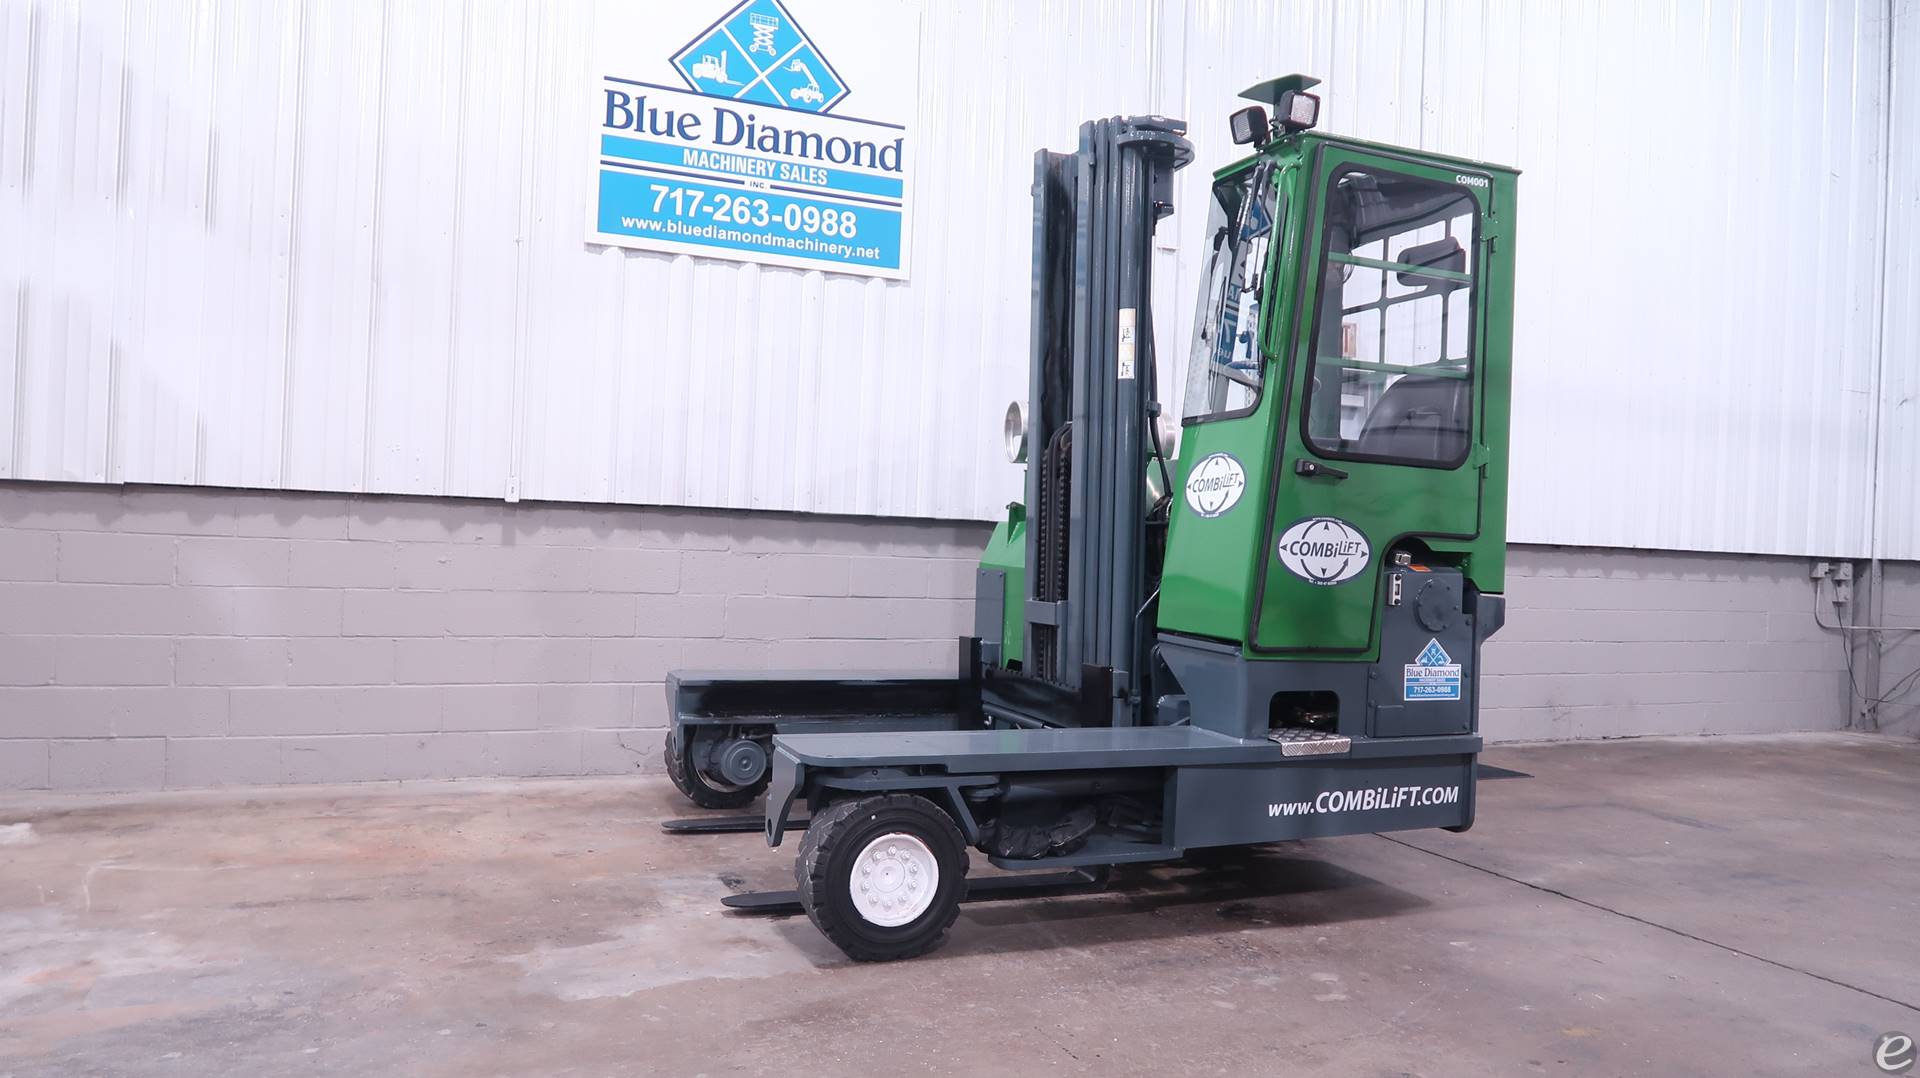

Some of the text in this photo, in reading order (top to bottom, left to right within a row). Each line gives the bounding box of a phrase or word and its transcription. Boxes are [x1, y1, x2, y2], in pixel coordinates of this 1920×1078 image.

[602, 89, 904, 173] Blue Diamond
[683, 149, 828, 185] MACHINERY SALES
[749, 180, 768, 190] INC.
[1455, 175, 1489, 188] COM001
[650, 184, 857, 238] 717-263-0988
[621, 216, 880, 259] www.bluediamondmachinery.net
[1406, 668, 1460, 677] Blue Diamond
